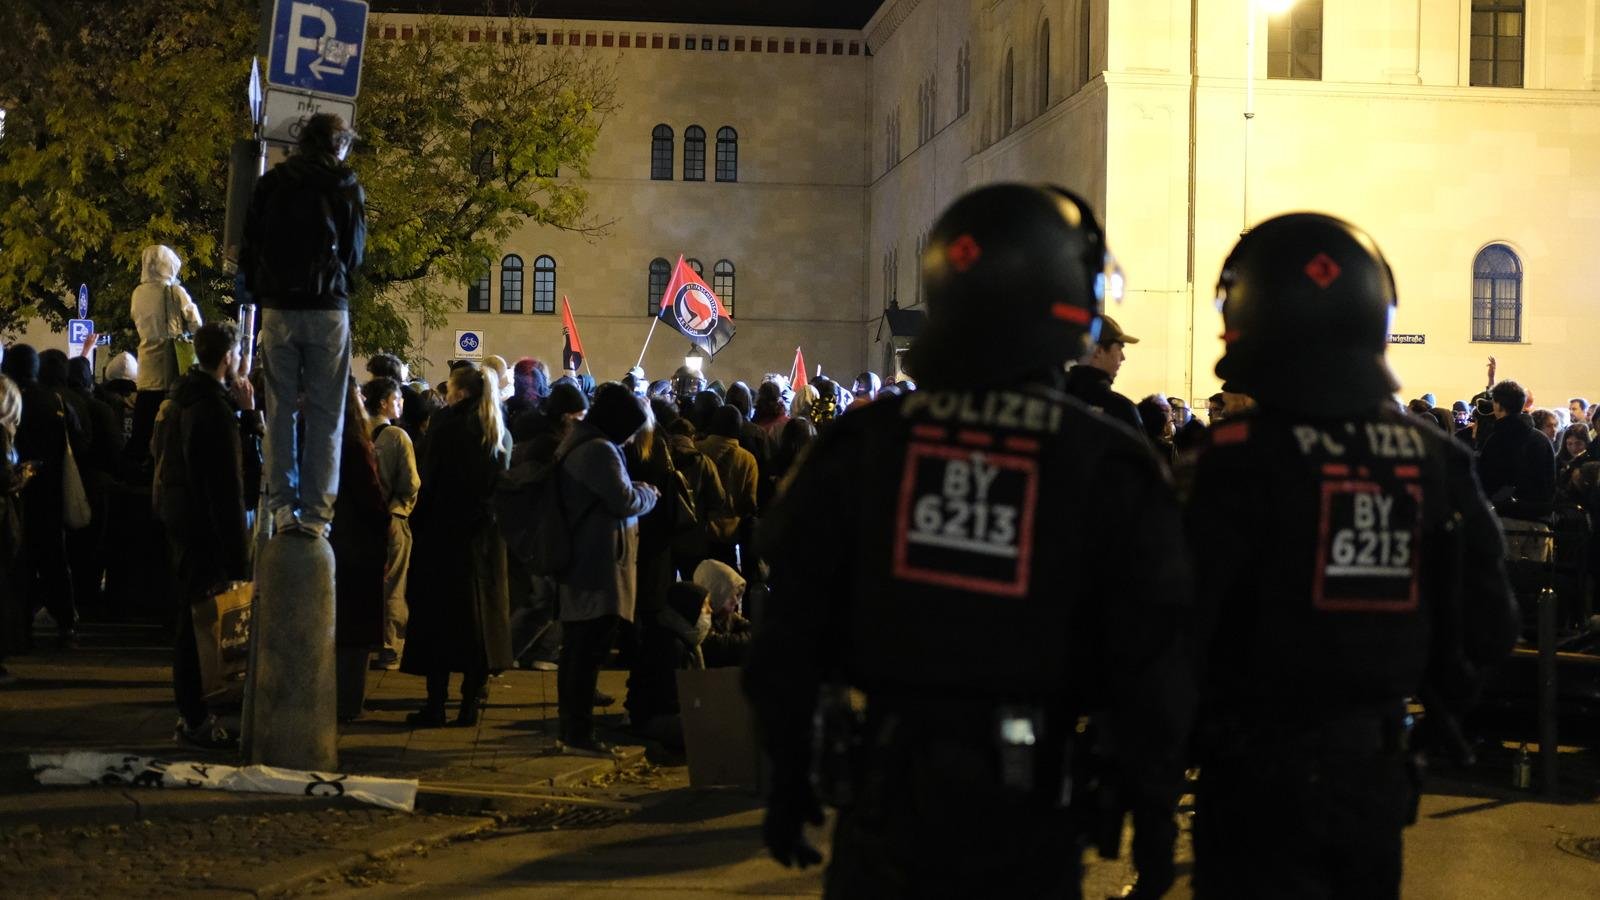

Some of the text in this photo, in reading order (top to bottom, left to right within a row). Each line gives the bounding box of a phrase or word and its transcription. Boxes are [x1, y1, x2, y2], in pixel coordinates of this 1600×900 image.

[284, 2, 337, 75] P
[902, 390, 1063, 433] POLIZEI
[942, 452, 999, 501] BY
[914, 494, 1017, 545] 6213
[1354, 493, 1394, 530] BY
[1331, 528, 1411, 567] 6213
